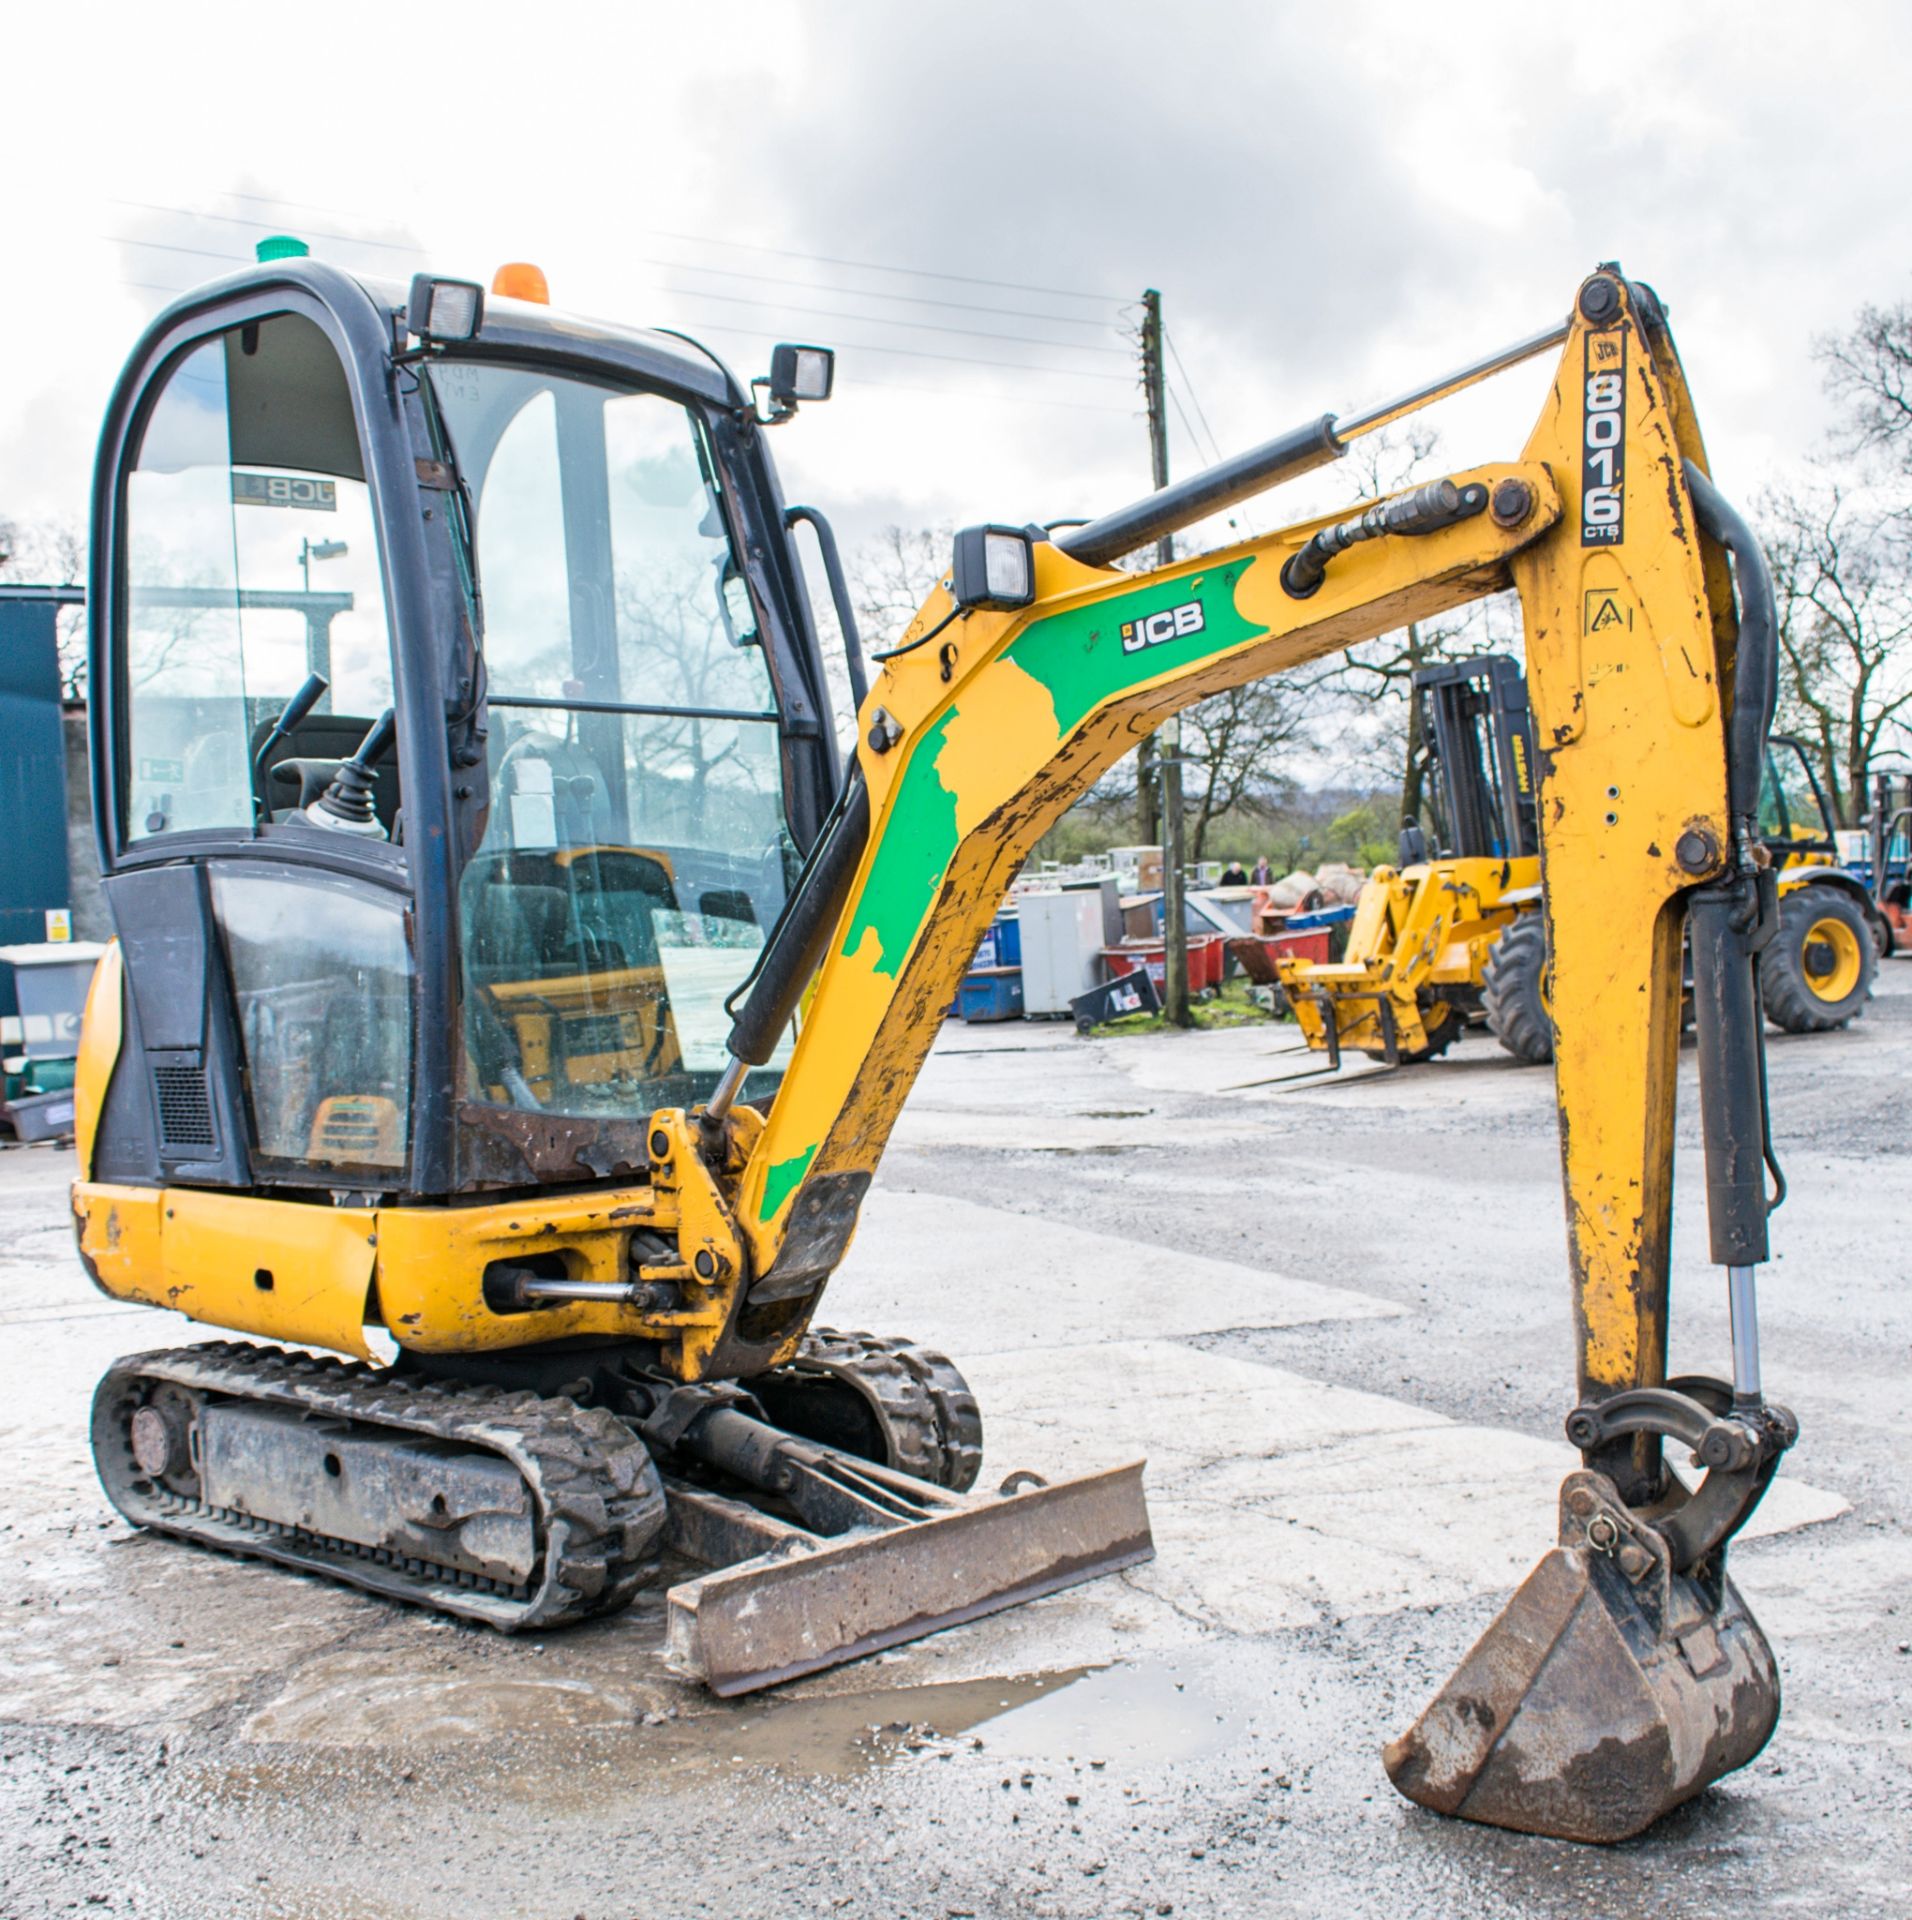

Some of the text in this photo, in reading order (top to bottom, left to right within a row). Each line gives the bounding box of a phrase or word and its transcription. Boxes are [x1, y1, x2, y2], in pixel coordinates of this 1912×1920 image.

[1597, 341, 1619, 361] JCB
[1584, 374, 1622, 525] 8016
[1584, 524, 1619, 538] CTS
[1123, 602, 1204, 652] JCB
[1511, 734, 1530, 793] HYSTER
